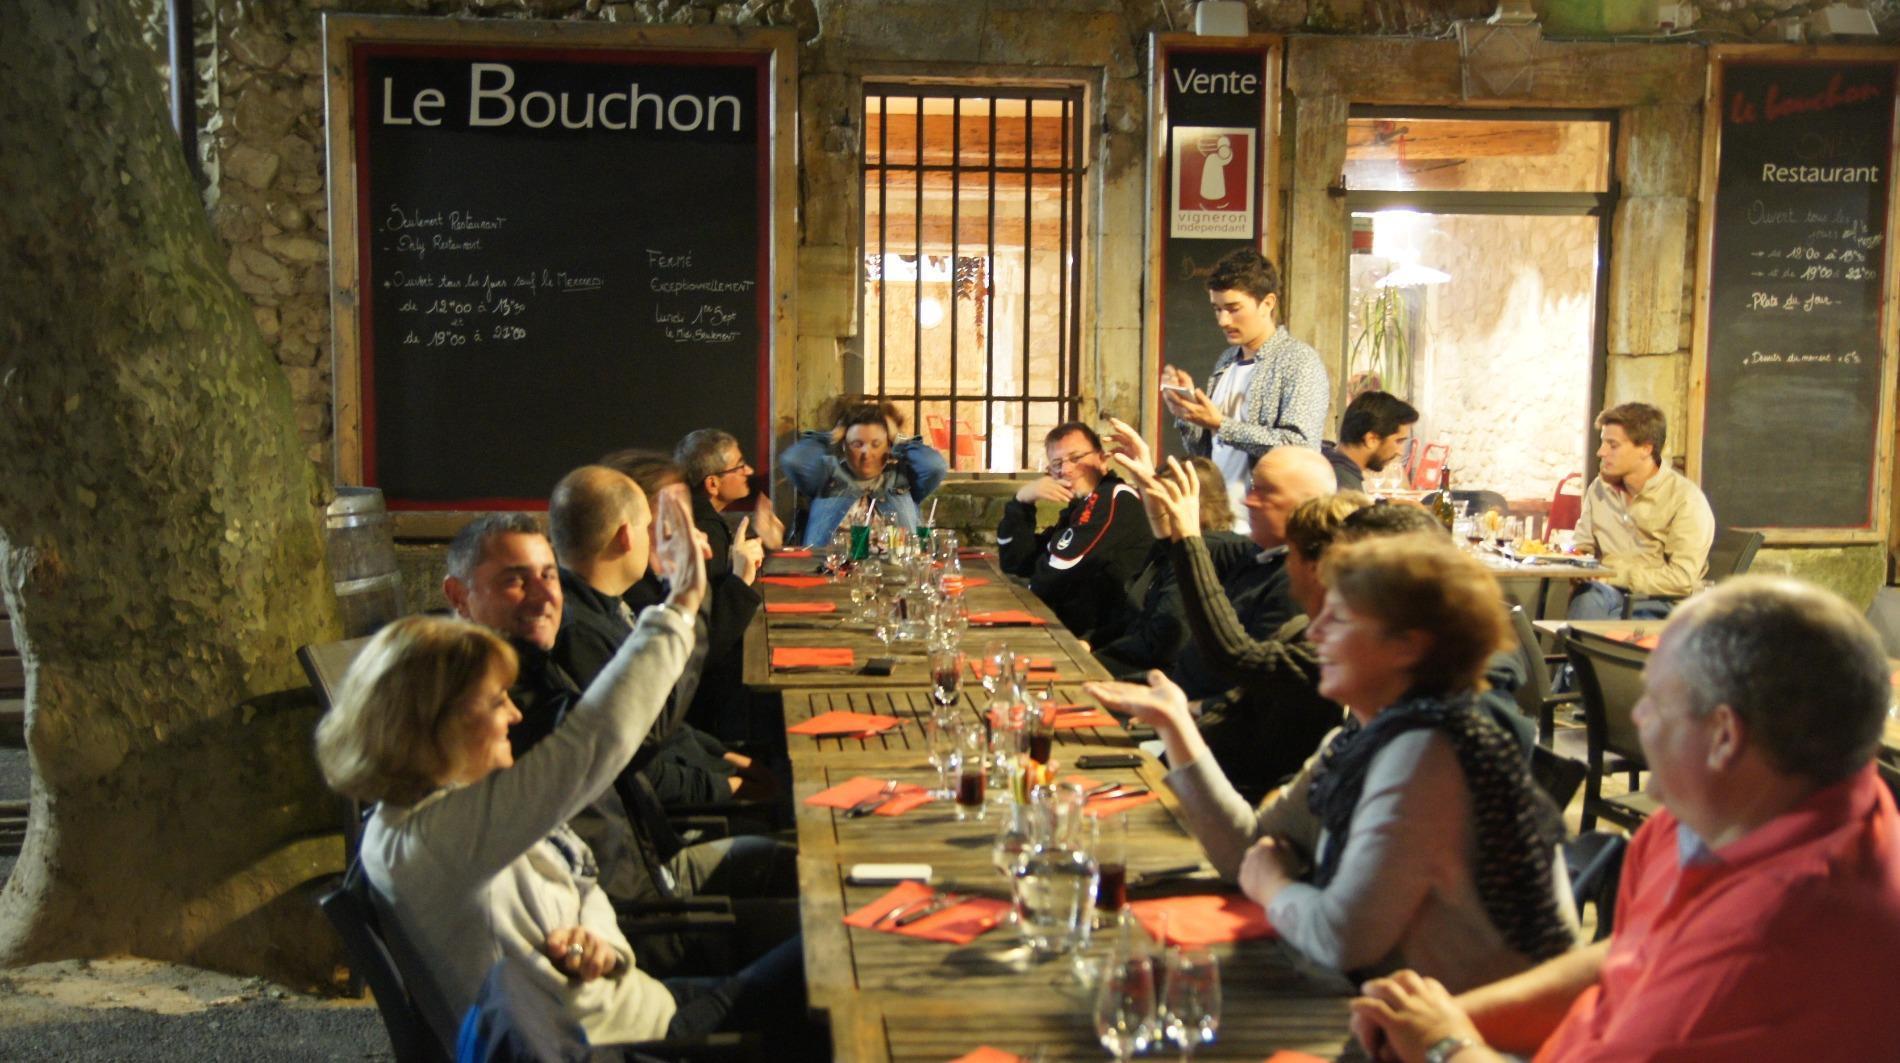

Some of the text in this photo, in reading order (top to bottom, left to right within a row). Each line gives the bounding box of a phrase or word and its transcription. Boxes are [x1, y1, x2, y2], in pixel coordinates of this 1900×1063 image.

[1173, 68, 1257, 95] Vente
[383, 62, 742, 132] Le Bouchon
[1762, 163, 1879, 183] Restaurant
[1178, 212, 1247, 226] vigneron
[1748, 200, 1797, 225] Ouvert
[477, 301, 488, 313] à
